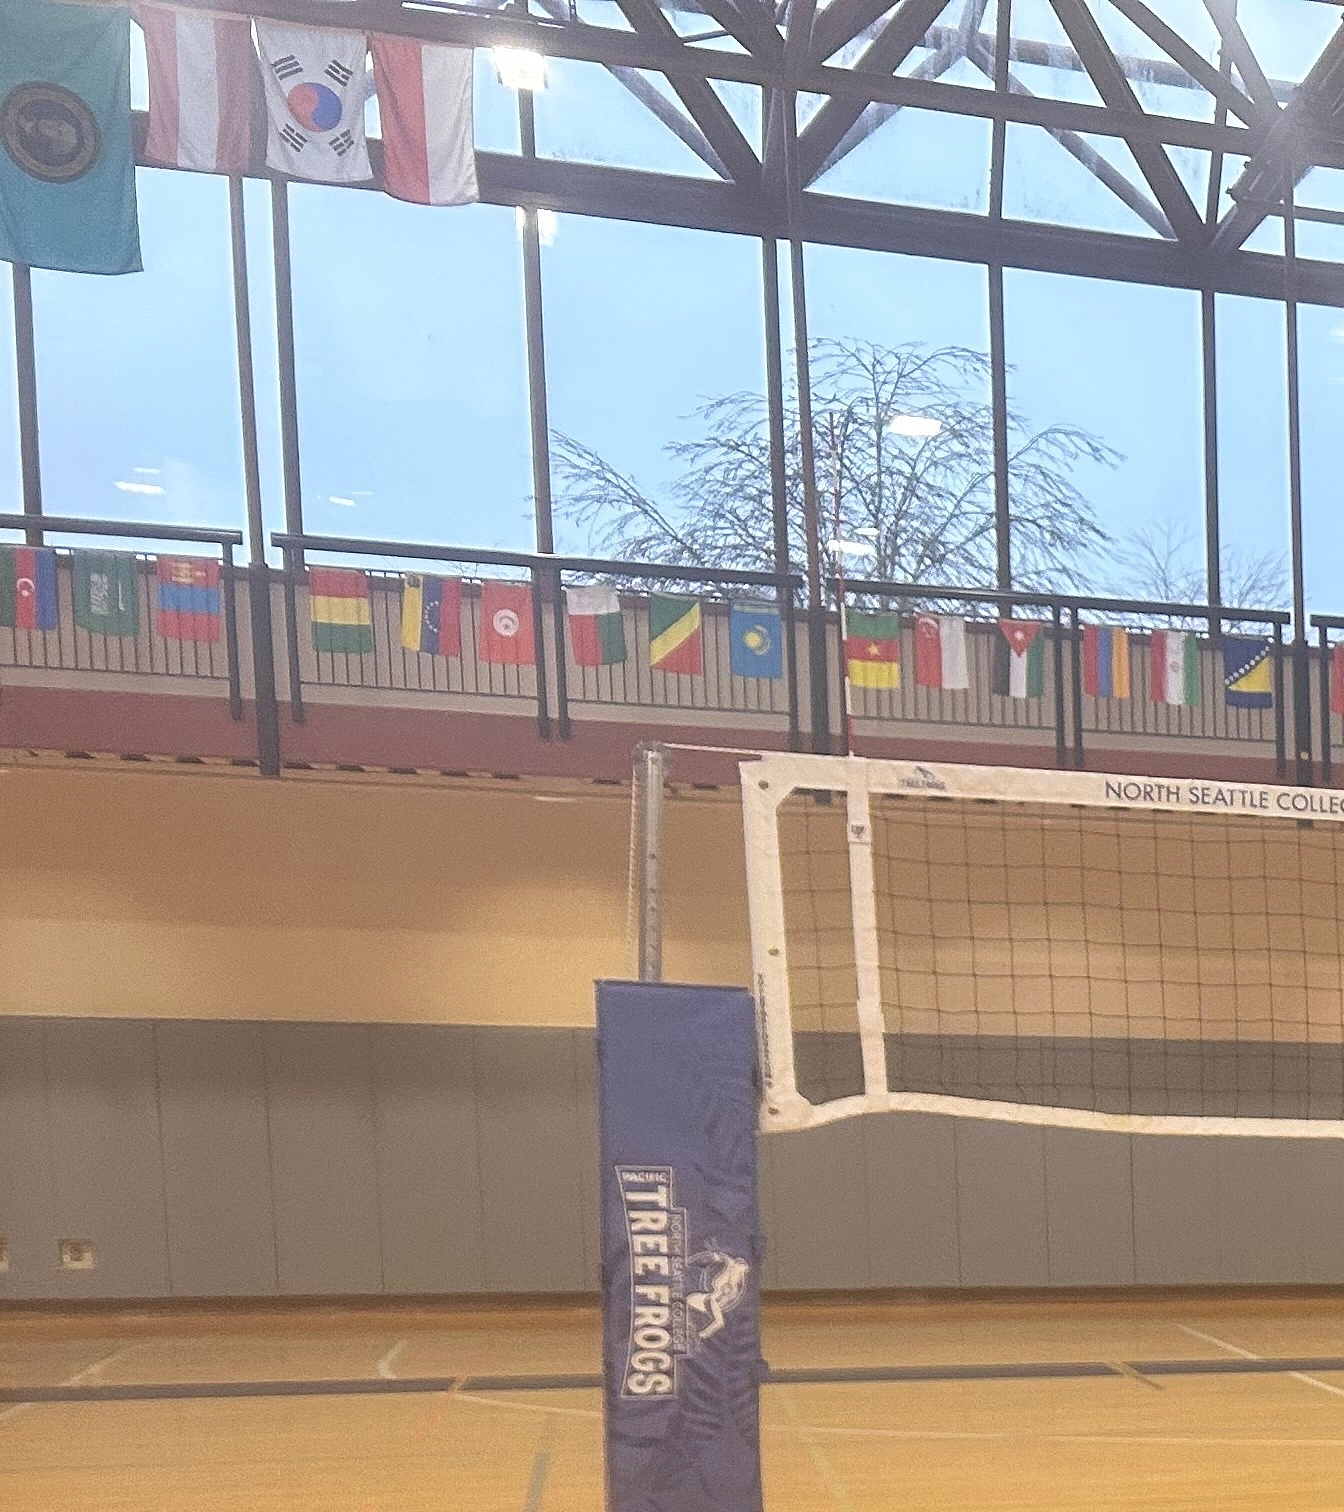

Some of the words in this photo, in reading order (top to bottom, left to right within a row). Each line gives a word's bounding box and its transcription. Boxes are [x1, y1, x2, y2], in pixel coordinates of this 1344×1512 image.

[1104, 780, 1180, 803] NORTH
[1188, 786, 1269, 810] SEATTLE
[621, 1171, 668, 1183] PACIFIC
[625, 1184, 669, 1276] TREE
[627, 1284, 673, 1394] FROGS
